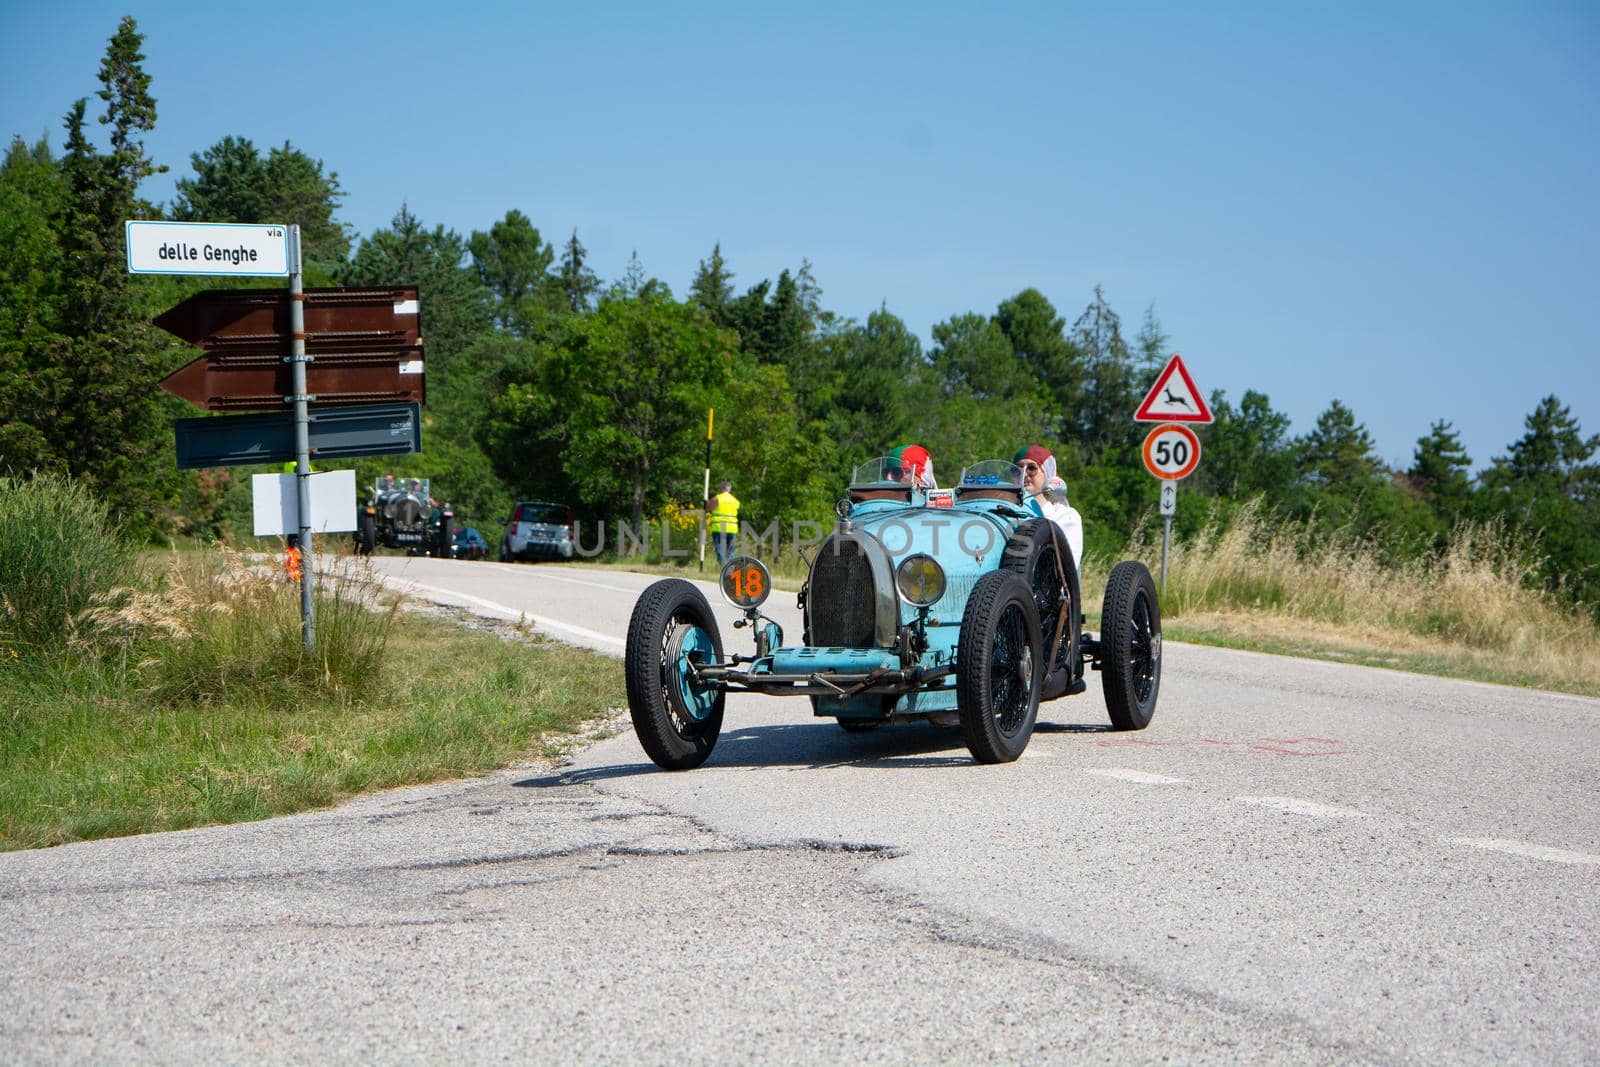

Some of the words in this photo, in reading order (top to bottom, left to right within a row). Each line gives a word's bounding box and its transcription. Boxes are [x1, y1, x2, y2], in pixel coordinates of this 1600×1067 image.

[267, 228, 282, 237] via
[159, 243, 197, 260] delle
[204, 244, 257, 265] Genghe
[1156, 441, 1188, 466] 50
[731, 569, 763, 597] 18
